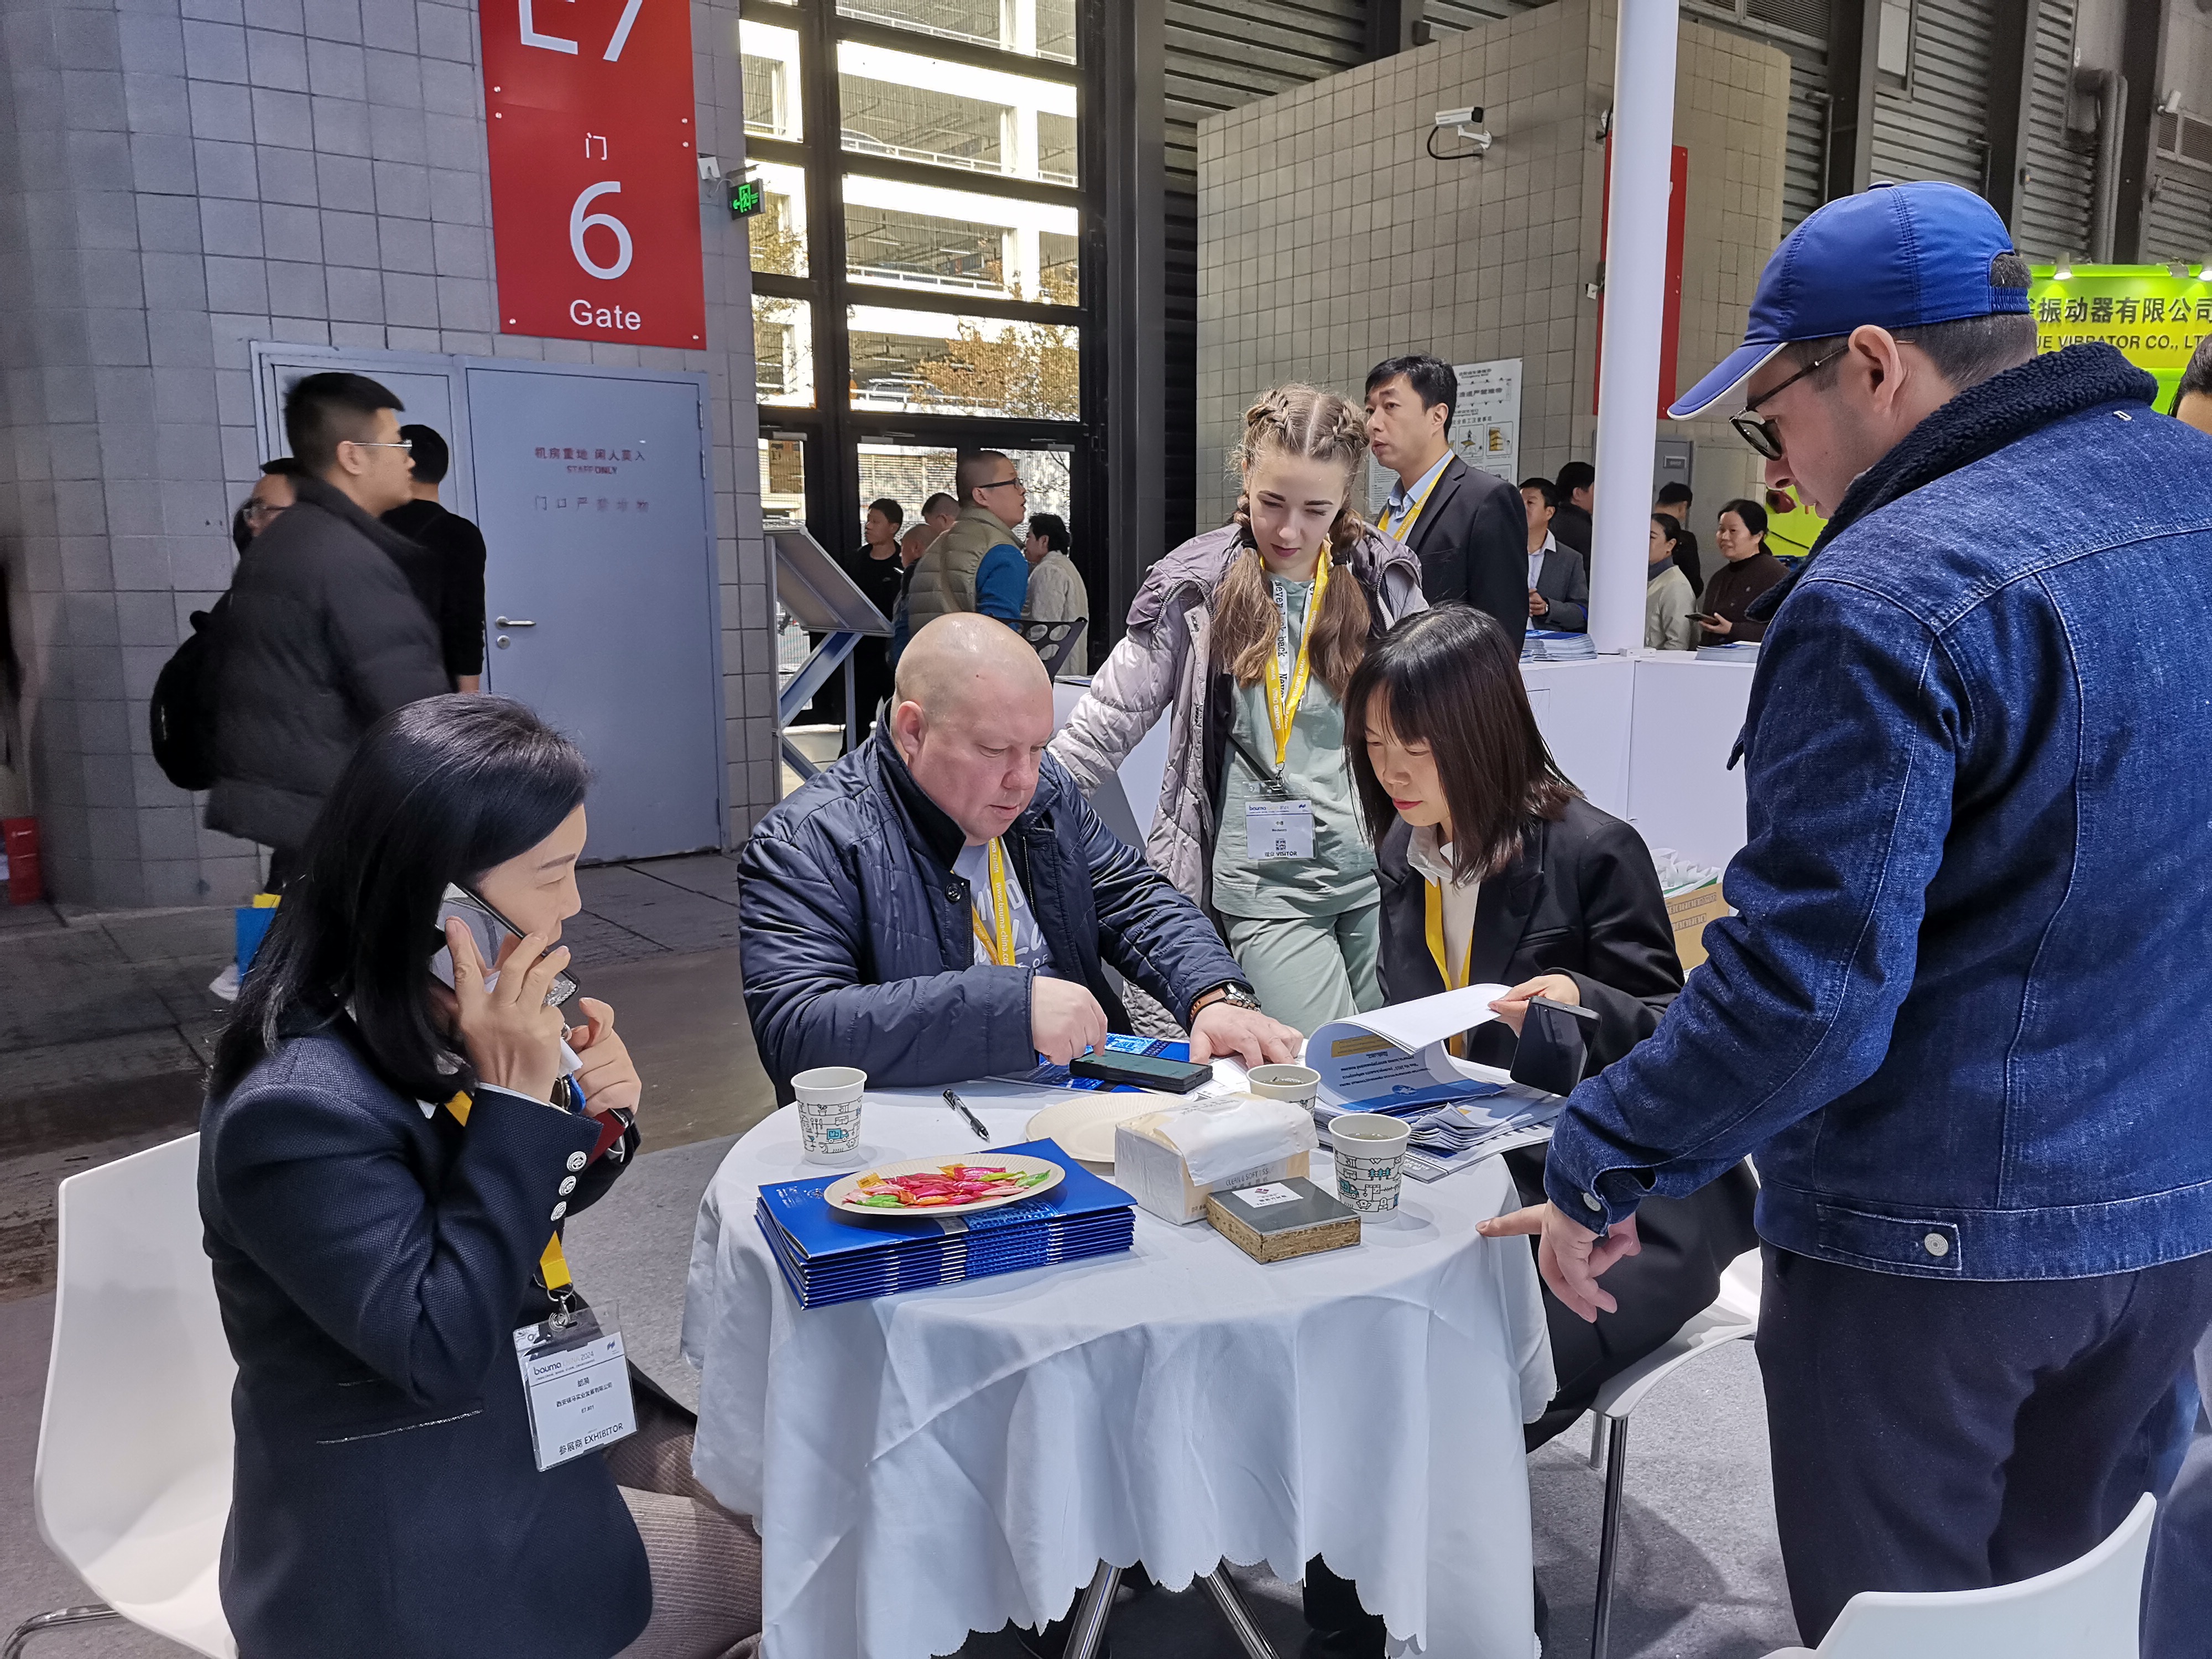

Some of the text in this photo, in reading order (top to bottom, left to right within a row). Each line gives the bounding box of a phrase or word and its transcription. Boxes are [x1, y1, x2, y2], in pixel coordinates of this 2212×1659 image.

[585, 132, 608, 160] 门
[570, 180, 633, 280] 6
[570, 299, 641, 331] Gate
[2029, 296, 2212, 324] 振动器有限公司
[2146, 335, 2178, 351] CO.,
[2184, 335, 2208, 349] LT
[594, 466, 618, 474] ONLY
[1274, 581, 1284, 608] Never
[1277, 636, 1287, 657] back
[1245, 1171, 1258, 1181] SOFT
[533, 1361, 562, 1376] bauma
[580, 1350, 594, 1361] 2024
[559, 1422, 624, 1455] 参展商 EXHIBITOR
